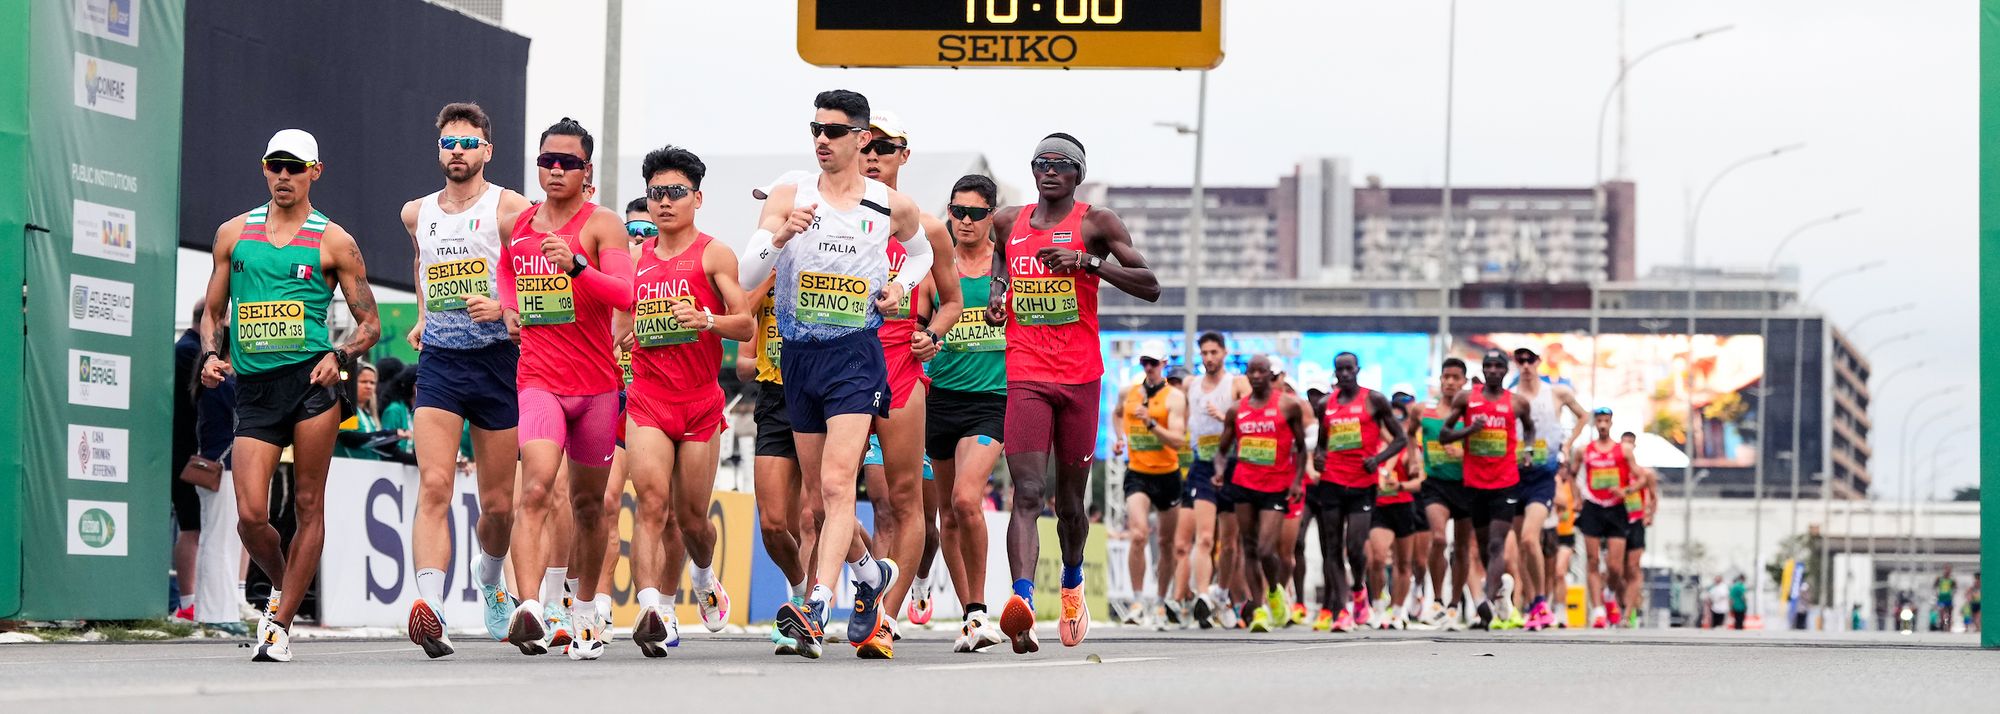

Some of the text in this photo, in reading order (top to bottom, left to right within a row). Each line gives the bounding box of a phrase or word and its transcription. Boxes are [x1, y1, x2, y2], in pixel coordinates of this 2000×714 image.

[938, 34, 1078, 63] SEIKO
[97, 76, 125, 100] CONFAE
[72, 162, 138, 194] PUBLIC INSTITUTIONS
[436, 246, 469, 256] ITALIA
[818, 242, 857, 255] ITALIA
[428, 260, 485, 280] SEIKO
[513, 255, 567, 275] CHIN
[429, 279, 488, 299] ORSONI 133
[516, 276, 569, 292] SEIKO
[637, 279, 691, 302] CHINA
[801, 274, 867, 295] SEIKO
[1013, 279, 1072, 294] SEIKO
[90, 291, 131, 309] ATLETISMO
[524, 295, 545, 311] HE
[800, 291, 865, 315] STANO 134
[1016, 297, 1076, 312] KIHU 250
[89, 305, 116, 321] BRASIL
[238, 303, 302, 321] SEIKO
[239, 321, 303, 340] DOCTOR 138
[636, 316, 679, 335] WANG
[948, 325, 996, 342] SALAZAR
[91, 366, 118, 386] BRASIL
[1238, 420, 1276, 434] KENYA
[91, 431, 104, 444] CASA
[91, 447, 111, 461] THOMAS
[92, 463, 117, 478] JEFFERSON
